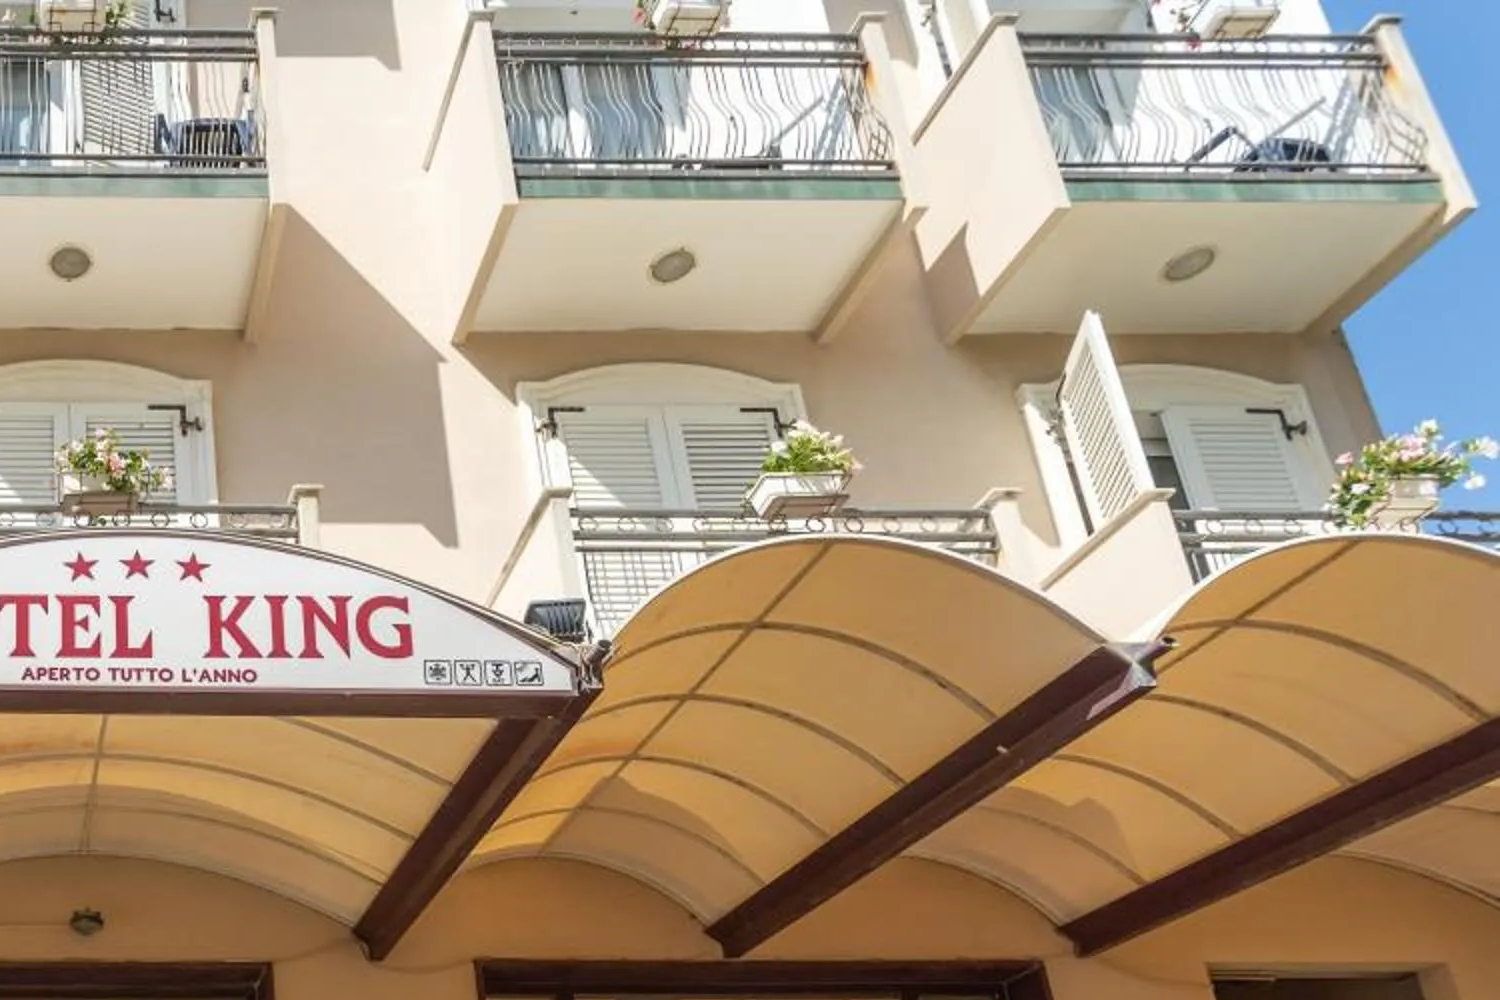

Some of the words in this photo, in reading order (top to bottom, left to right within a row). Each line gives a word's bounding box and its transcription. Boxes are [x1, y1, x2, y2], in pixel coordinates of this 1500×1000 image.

[202, 595, 415, 660] KING
[21, 667, 100, 682] APERTO
[108, 667, 174, 682] TUTTO
[182, 668, 258, 683] L'ANNO
